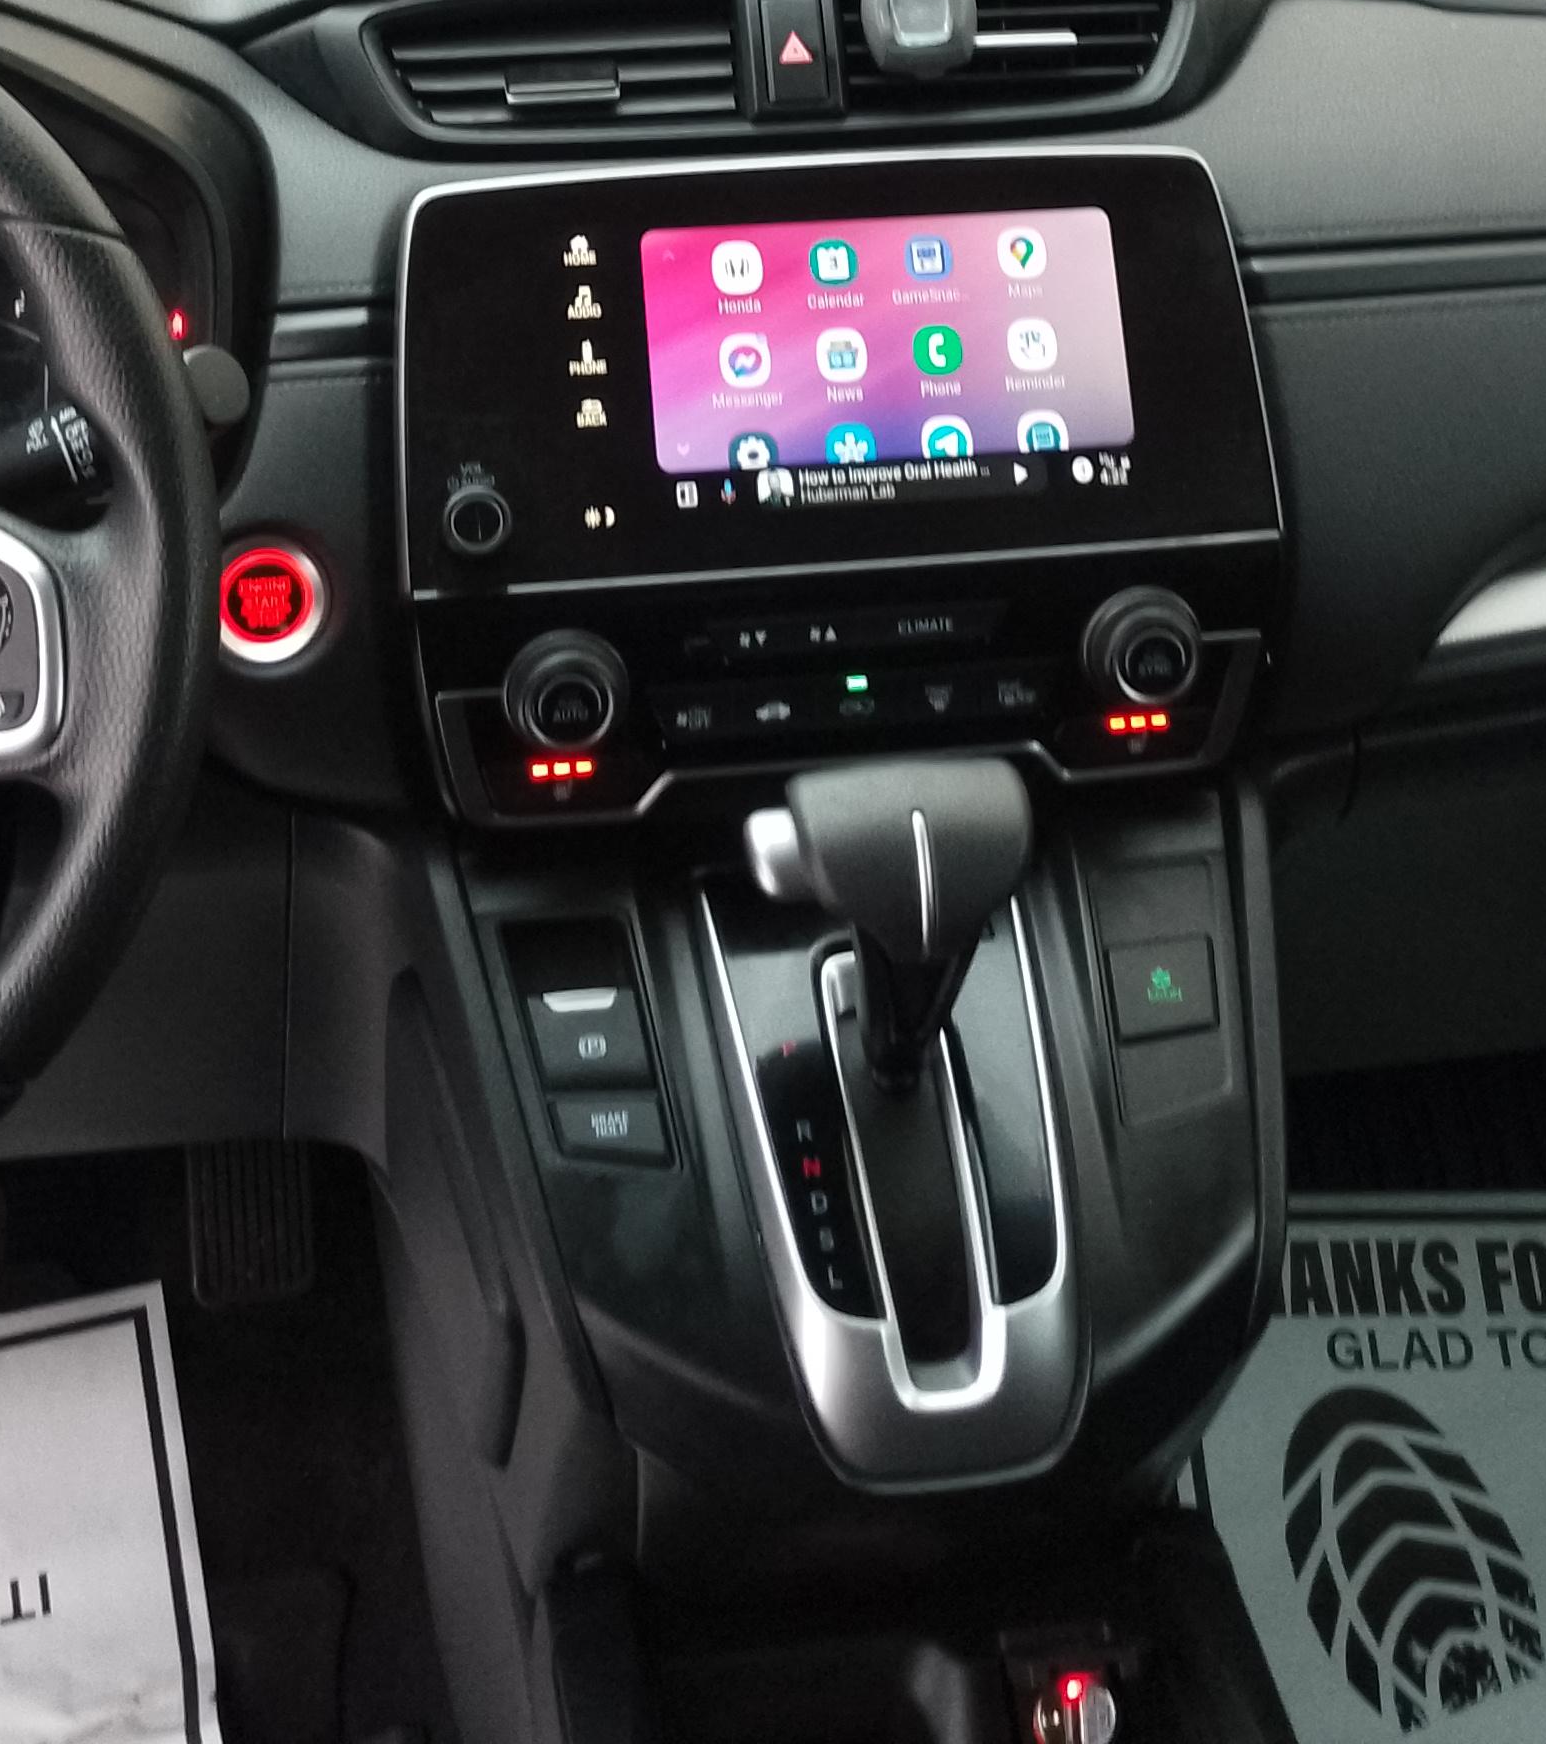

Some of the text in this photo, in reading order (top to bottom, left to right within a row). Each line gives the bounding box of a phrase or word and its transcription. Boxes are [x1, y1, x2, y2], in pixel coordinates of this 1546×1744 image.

[563, 250, 597, 267] HOME
[1008, 283, 1044, 299] Maps
[717, 297, 762, 315] Honda
[807, 292, 865, 310] Calendar
[567, 303, 602, 320] AUDIO
[569, 359, 608, 376] PHONE
[920, 380, 962, 399] Phone
[1004, 375, 1066, 393] Reminder
[711, 392, 783, 410] Messenger
[826, 386, 864, 403] News
[798, 468, 829, 487] How
[831, 467, 846, 485] to
[849, 463, 902, 488] Improve
[904, 461, 932, 481] Oral
[934, 457, 979, 480] Health
[800, 483, 896, 505] Huberman Lab
[898, 616, 952, 635] CLIMATE
[810, 1190, 828, 1215] D
[827, 1264, 843, 1290] L
[1273, 1236, 1467, 1317] ANKS
[1325, 1326, 1475, 1370] GLAD
